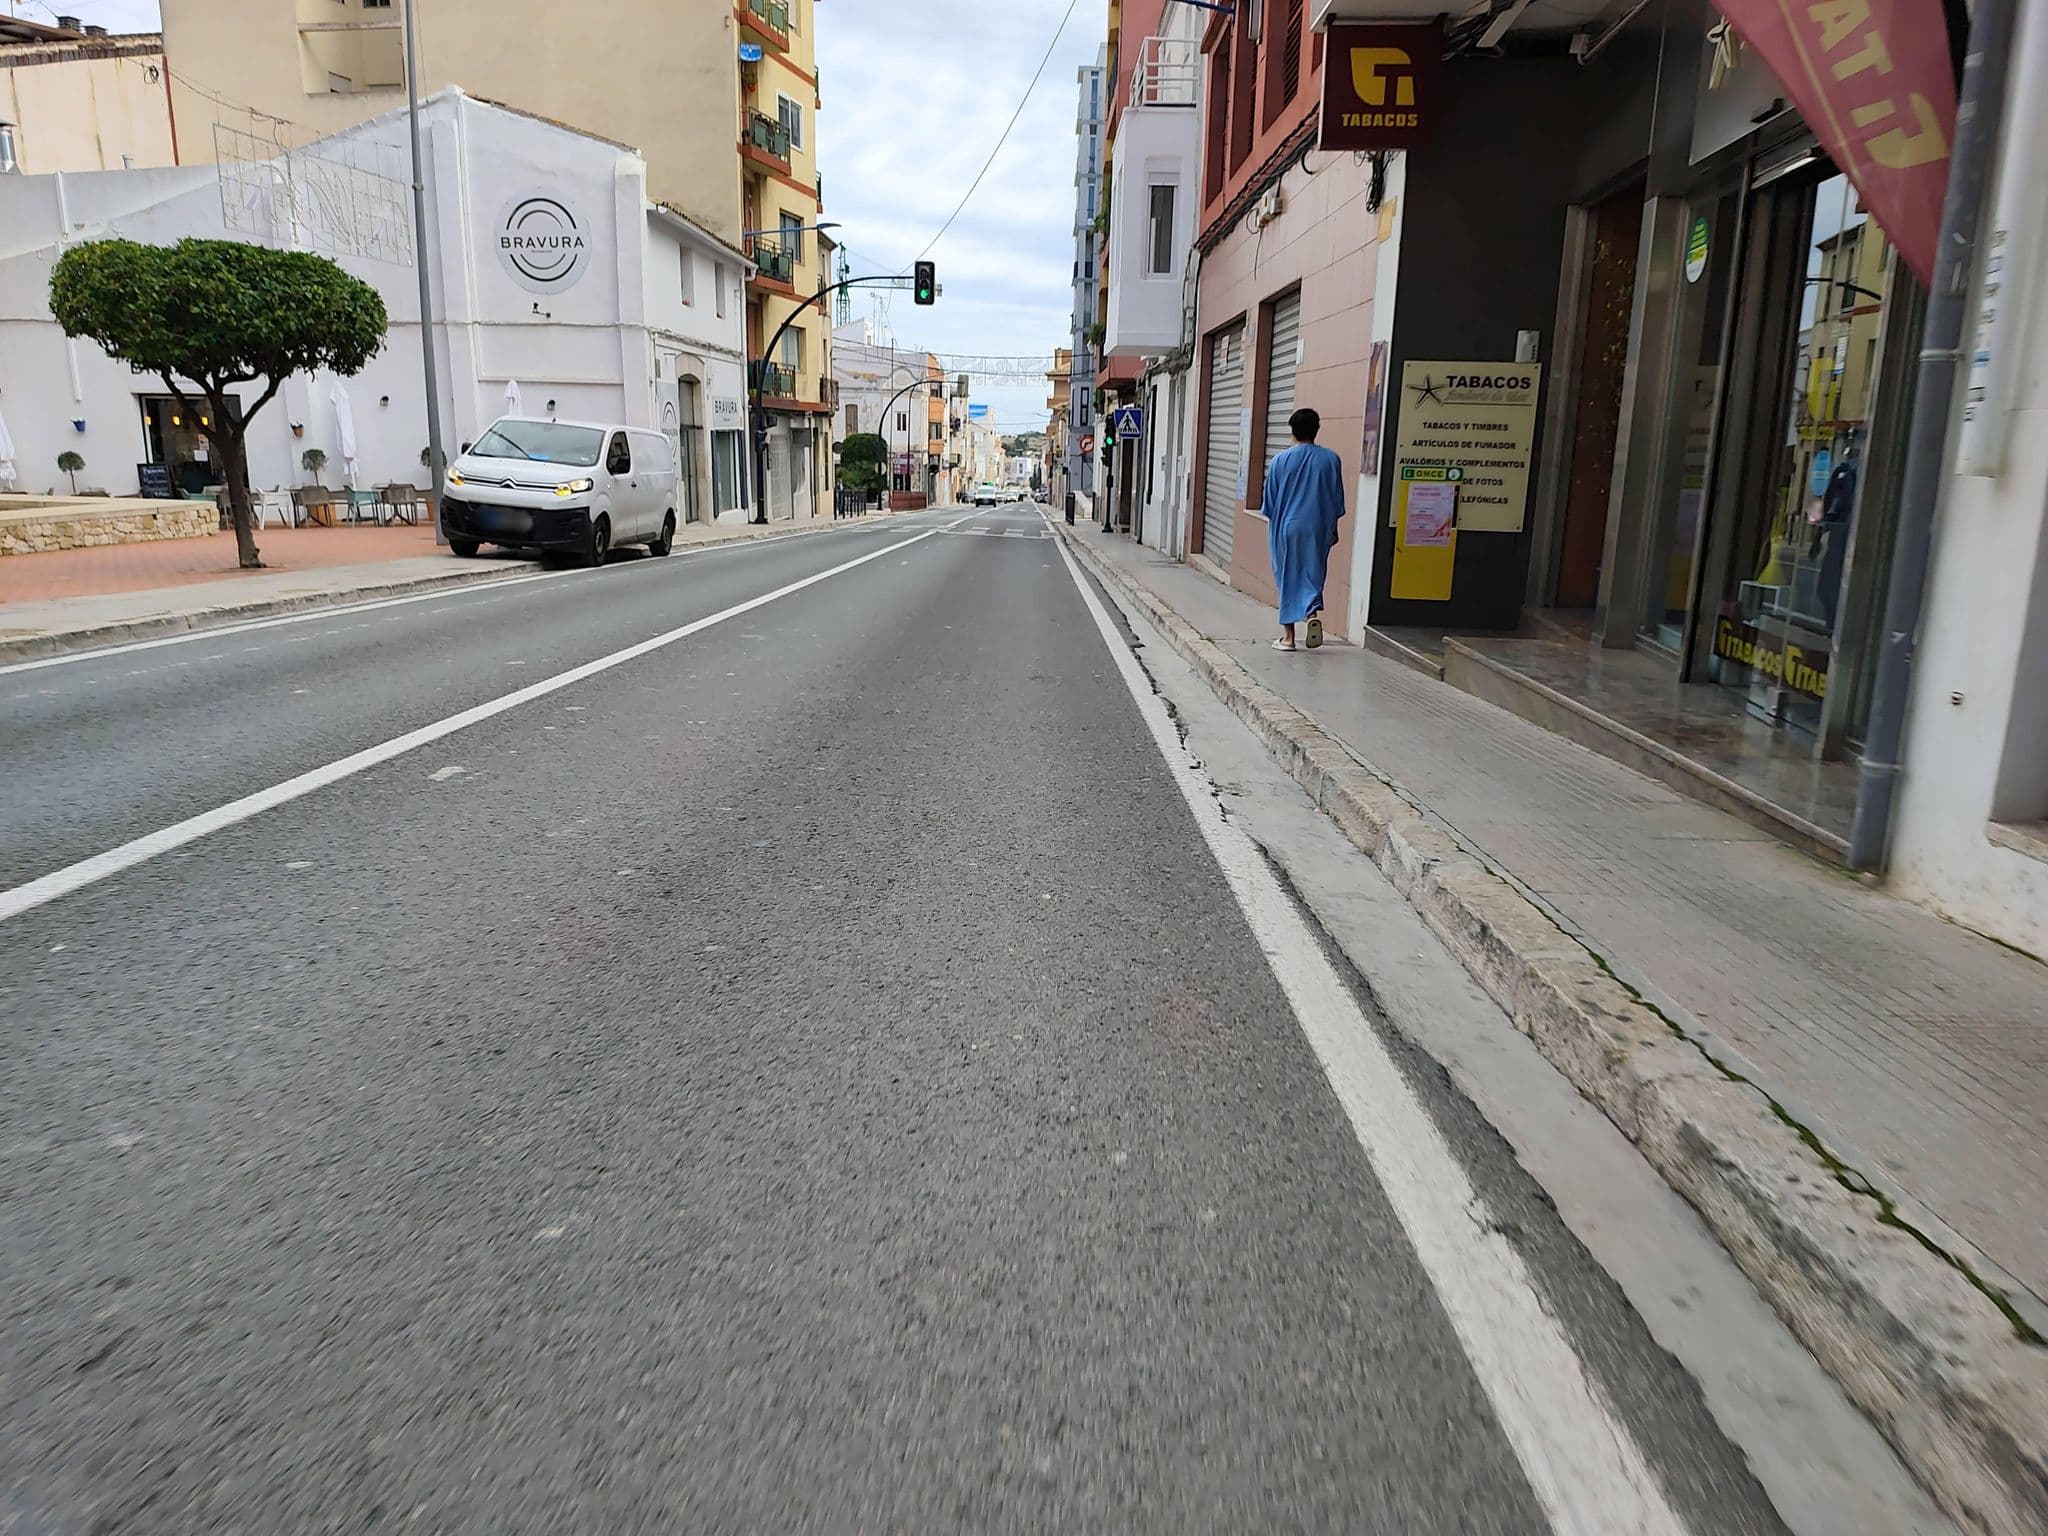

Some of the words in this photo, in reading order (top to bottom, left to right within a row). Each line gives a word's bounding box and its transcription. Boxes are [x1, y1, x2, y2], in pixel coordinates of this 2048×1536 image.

[1341, 113, 1418, 127] TABACOS
[501, 236, 584, 249] BRAVURA
[1446, 375, 1531, 389] TABACOS
[714, 400, 738, 414] BRAVURA
[1422, 422, 1461, 431] TABACOS
[1464, 422, 1470, 431] Y
[1471, 423, 1509, 431] TIMBRES
[1412, 438, 1459, 448] ARTÍCULOS
[1461, 441, 1472, 449] DE
[1475, 441, 1516, 449] FUMADOR
[1448, 458, 1454, 466] Y
[1456, 459, 1525, 468] COMPLEMENTOS
[1463, 478, 1474, 486] DE
[1476, 478, 1503, 486] FOTOS
[1460, 495, 1509, 505] LEFÓNICAS
